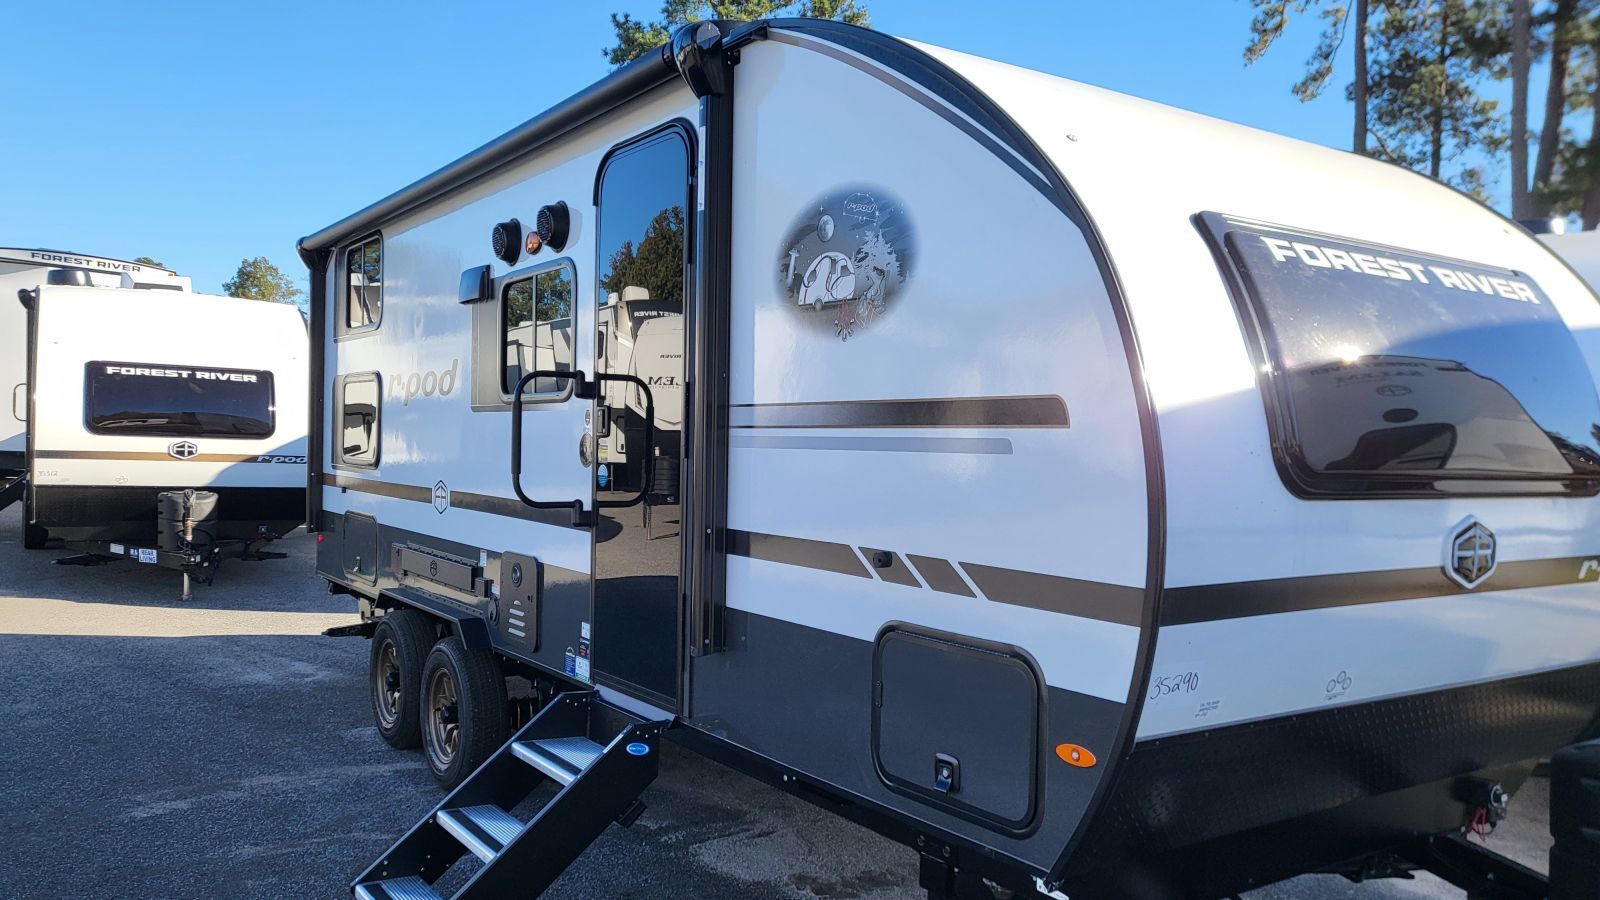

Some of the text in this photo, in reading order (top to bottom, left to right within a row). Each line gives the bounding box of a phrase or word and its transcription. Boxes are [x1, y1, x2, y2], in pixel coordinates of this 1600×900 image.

[31, 252, 142, 273] FOREST RIVER
[1260, 236, 1542, 305] FOREST RIVER
[106, 366, 258, 383] FOREST RIVER
[1150, 671, 1199, 700] 35290
